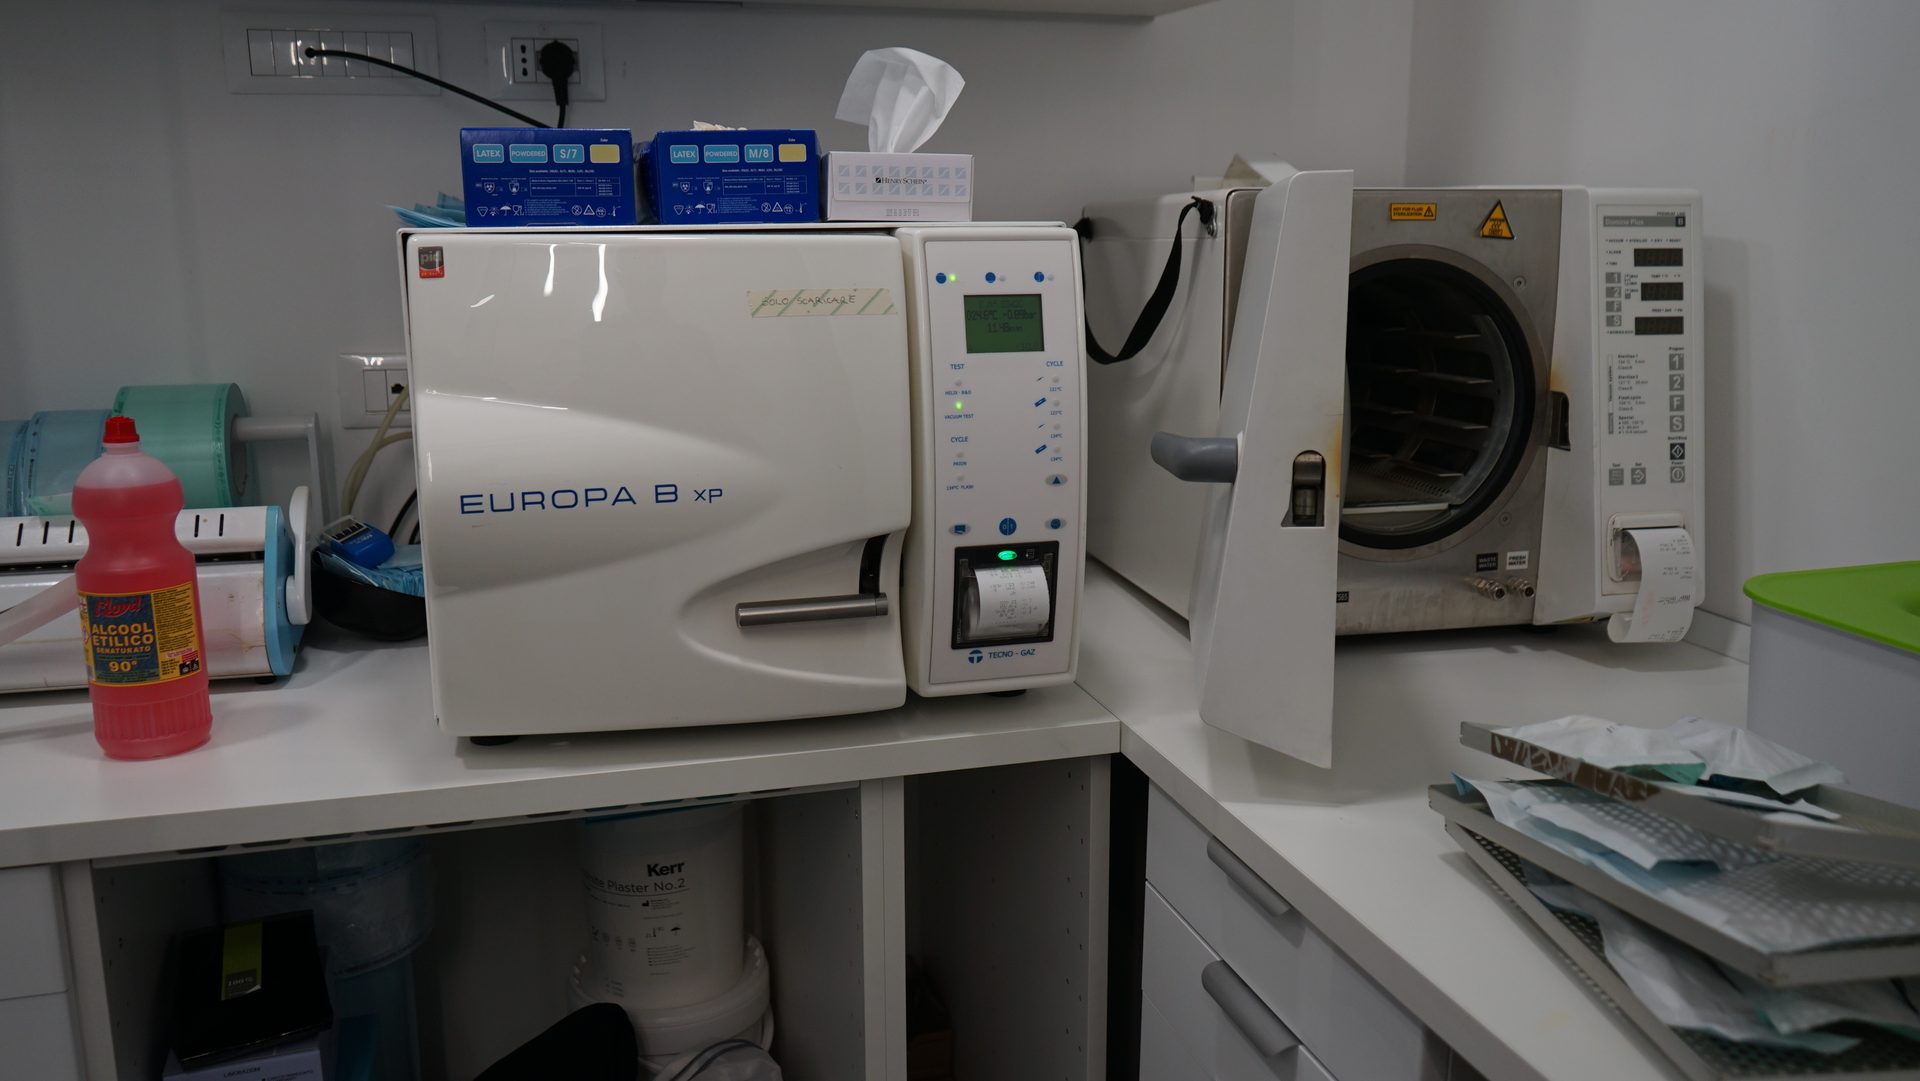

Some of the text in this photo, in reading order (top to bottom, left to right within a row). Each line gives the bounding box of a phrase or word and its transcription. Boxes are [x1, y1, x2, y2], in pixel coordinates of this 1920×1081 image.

[476, 149, 501, 158] LATEX
[560, 148, 578, 160] S/7
[749, 148, 769, 159] M/8
[1672, 375, 1681, 389] 2
[1673, 396, 1681, 409] F
[1672, 416, 1681, 431] S
[460, 486, 637, 514] EUROPA
[654, 484, 678, 504] B
[92, 622, 152, 635] ALCOOL
[93, 634, 154, 646] ETILICO
[96, 646, 151, 655] DENATURATO
[989, 650, 1013, 659] TECNO
[108, 660, 137, 673] 90°
[647, 862, 685, 877] Kerr
[607, 879, 649, 894] Plaster
[654, 878, 685, 892] No.2
